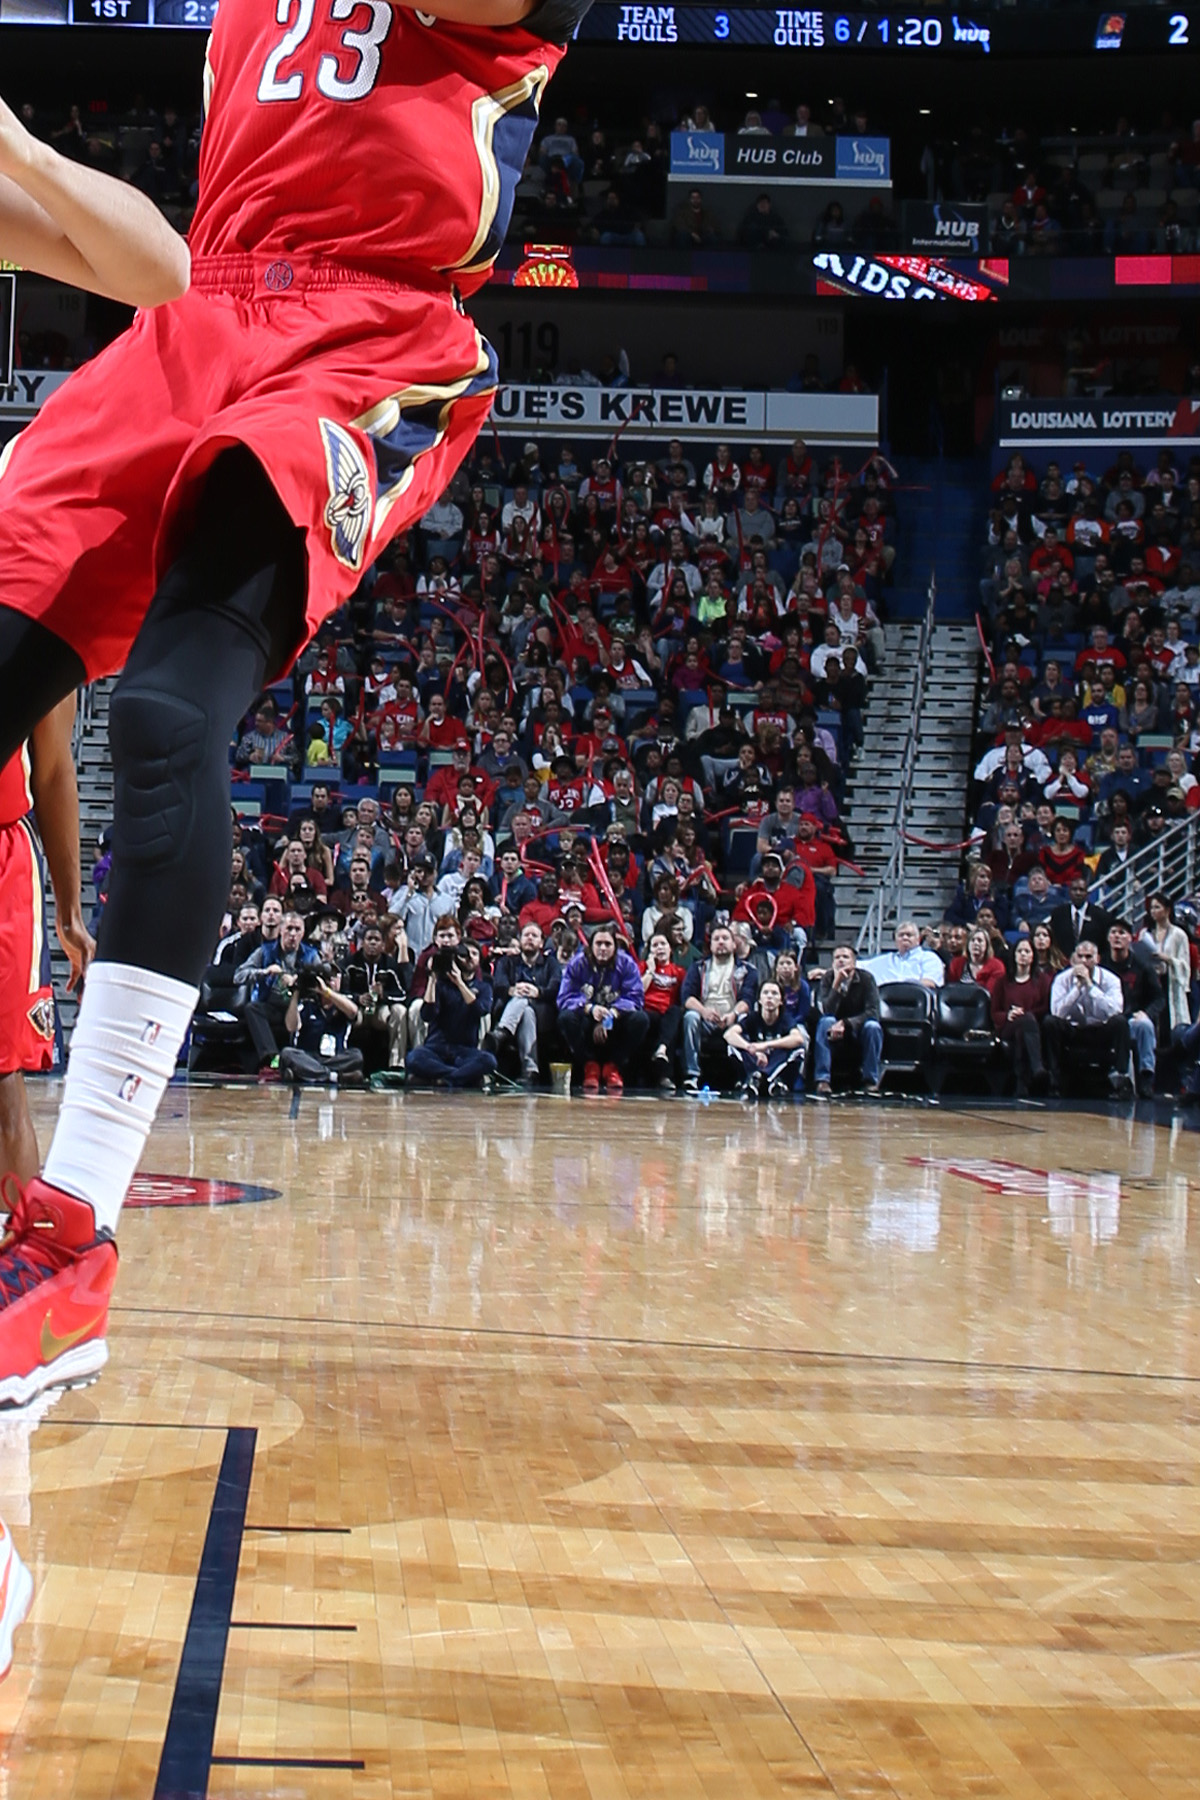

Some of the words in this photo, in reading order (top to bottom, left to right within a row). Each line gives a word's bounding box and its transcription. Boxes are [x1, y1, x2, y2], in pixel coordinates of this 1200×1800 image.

[91, 0, 132, 18] 1ST
[618, 5, 675, 25] TEAM
[617, 24, 678, 43] FOULS
[713, 14, 730, 38] 3
[775, 10, 823, 29] TIME
[773, 28, 825, 47] OUTS
[834, 18, 850, 42] 6
[737, 147, 777, 165] HUB
[782, 149, 824, 166] Club
[935, 220, 980, 237] HUB
[911, 237, 971, 248] International
[498, 320, 560, 369] 119
[599, 391, 748, 425] KREWE
[1011, 411, 1097, 430] LOUISIANA
[1103, 410, 1177, 429] LOTTERY
